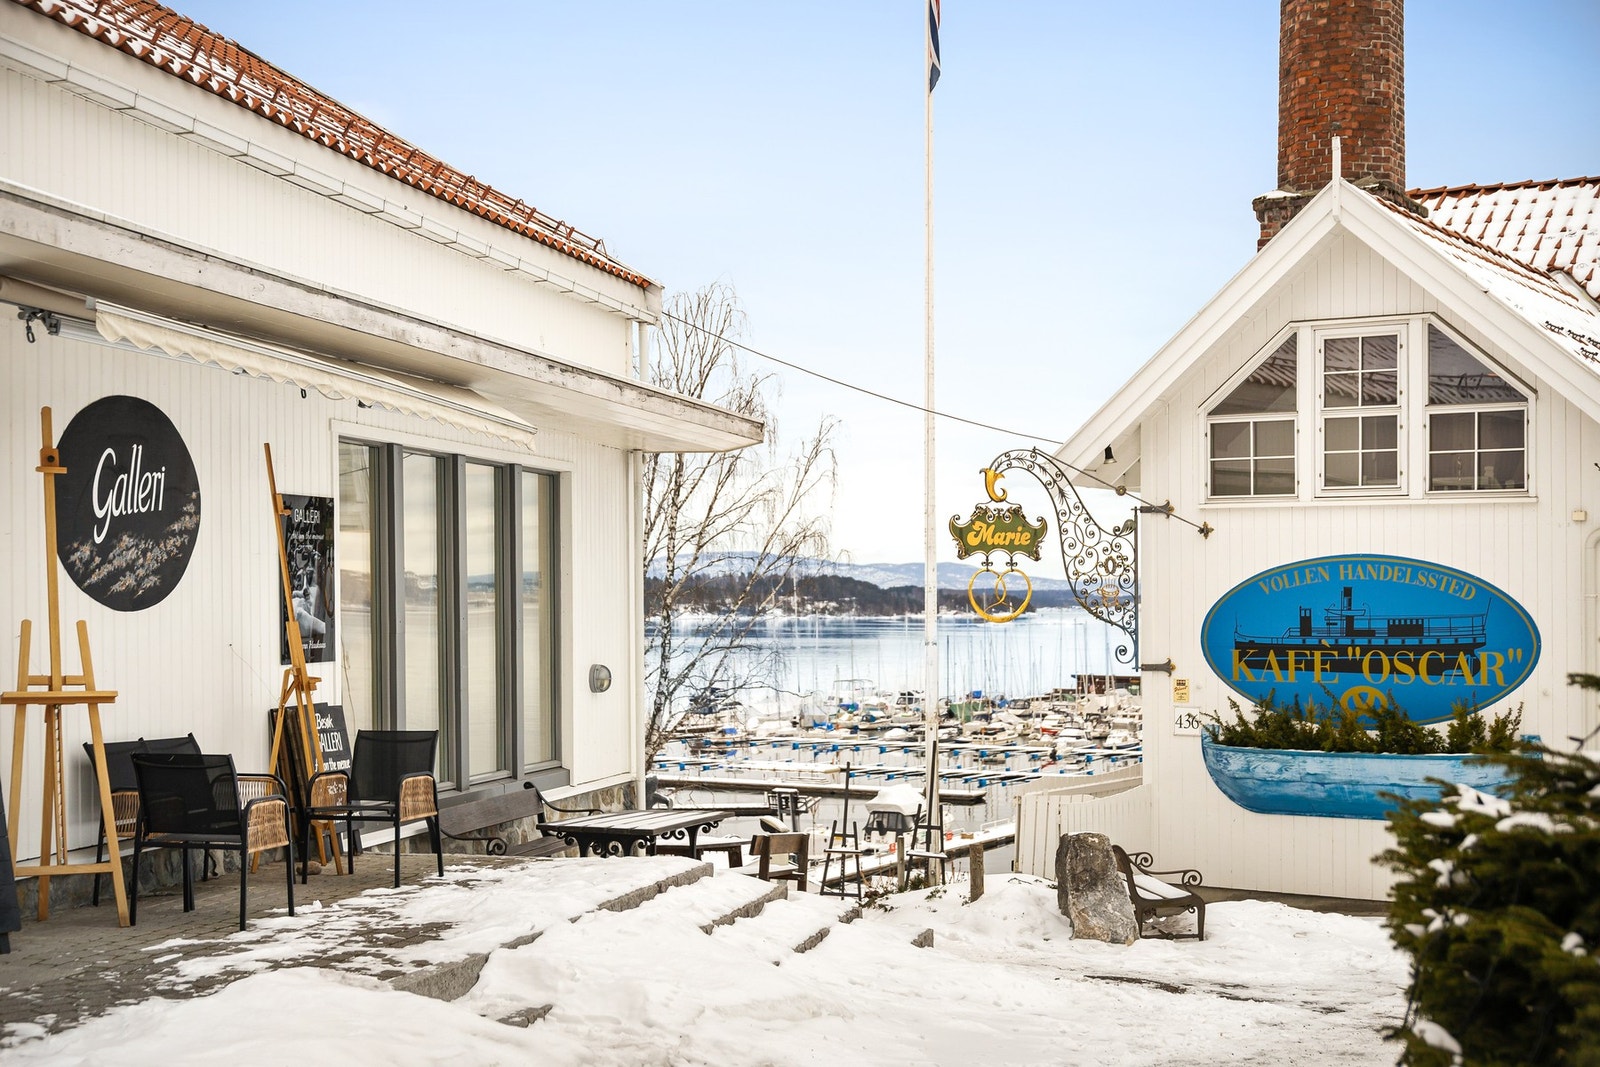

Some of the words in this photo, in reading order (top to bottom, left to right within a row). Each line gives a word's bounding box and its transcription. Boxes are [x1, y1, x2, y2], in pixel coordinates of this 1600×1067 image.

[92, 443, 166, 545] Galleri
[294, 508, 321, 524] GALLERI
[966, 520, 1031, 547] Marie
[1258, 565, 1331, 595] VOLLEN
[1338, 563, 1477, 601] HANDELSSTED
[1347, 646, 1523, 687] "OSCAR"
[315, 713, 334, 729] Besøk
[1175, 713, 1200, 730] 436
[317, 731, 343, 753] ALLERI
[329, 757, 337, 771] the
